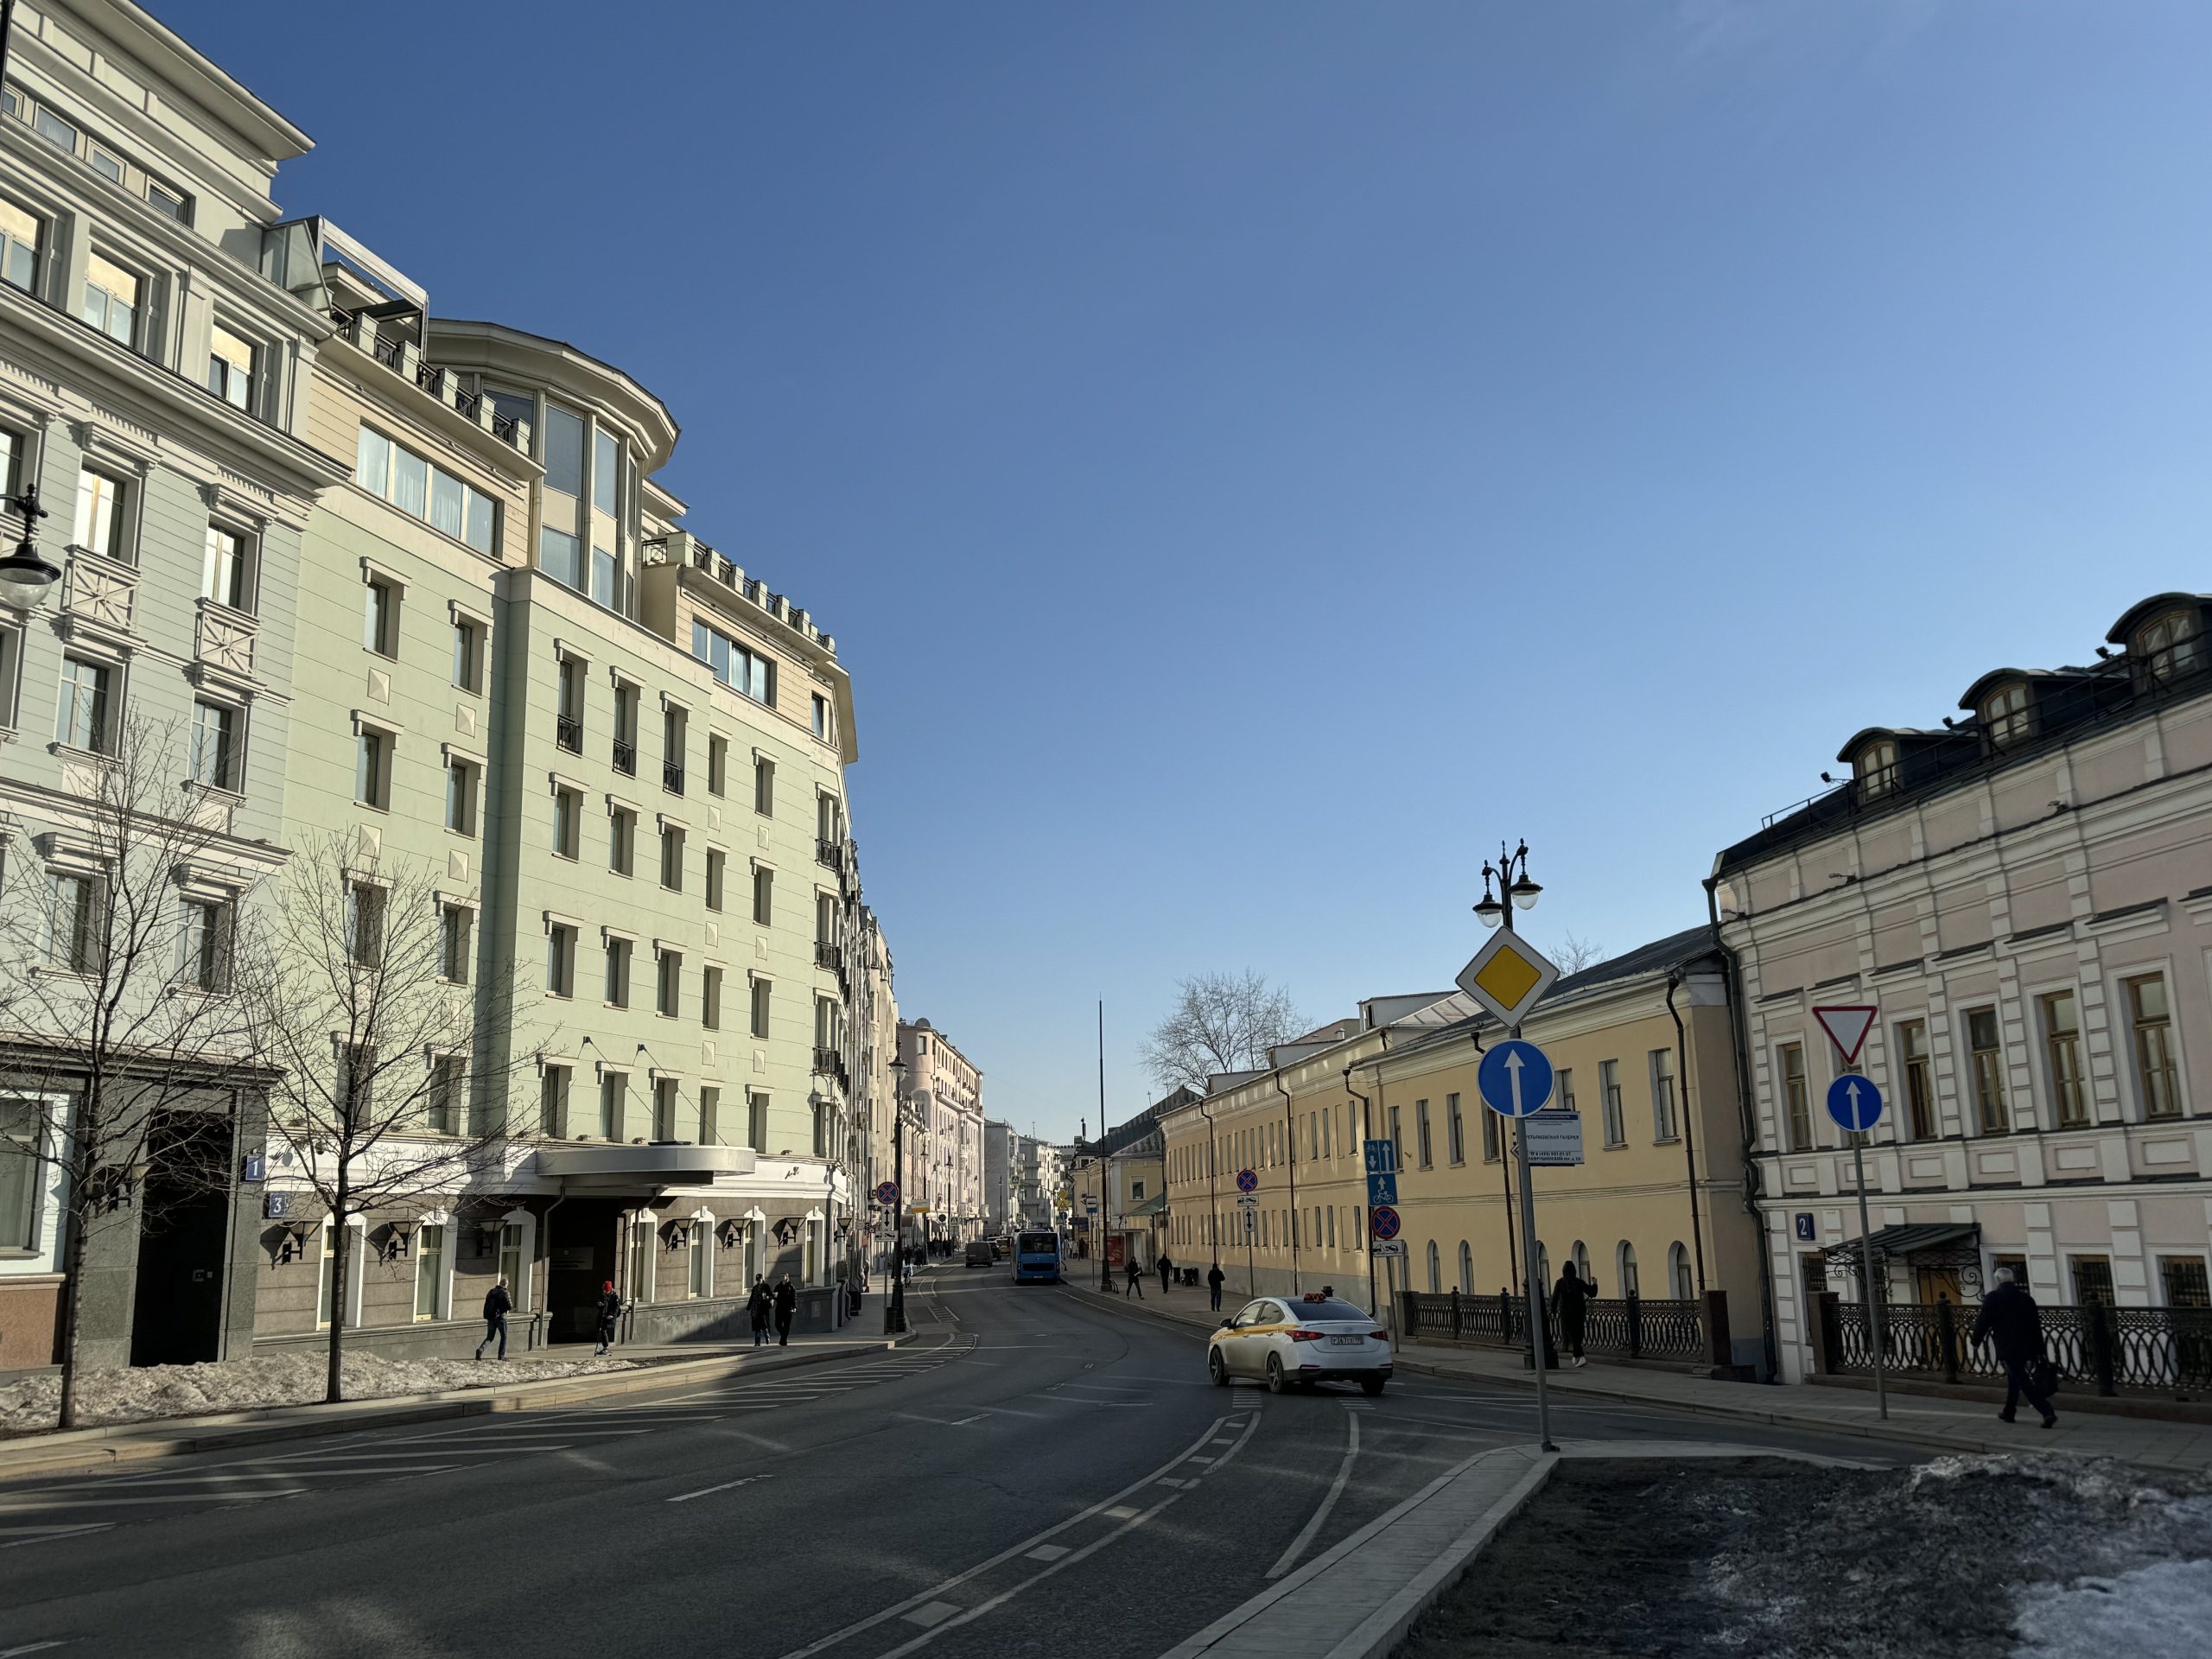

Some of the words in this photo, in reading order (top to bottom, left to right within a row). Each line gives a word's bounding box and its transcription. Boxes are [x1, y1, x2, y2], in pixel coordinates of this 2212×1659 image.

[253, 1160, 258, 1176] 1
[273, 1198, 283, 1213] 3
[1799, 1217, 1808, 1236] 2
